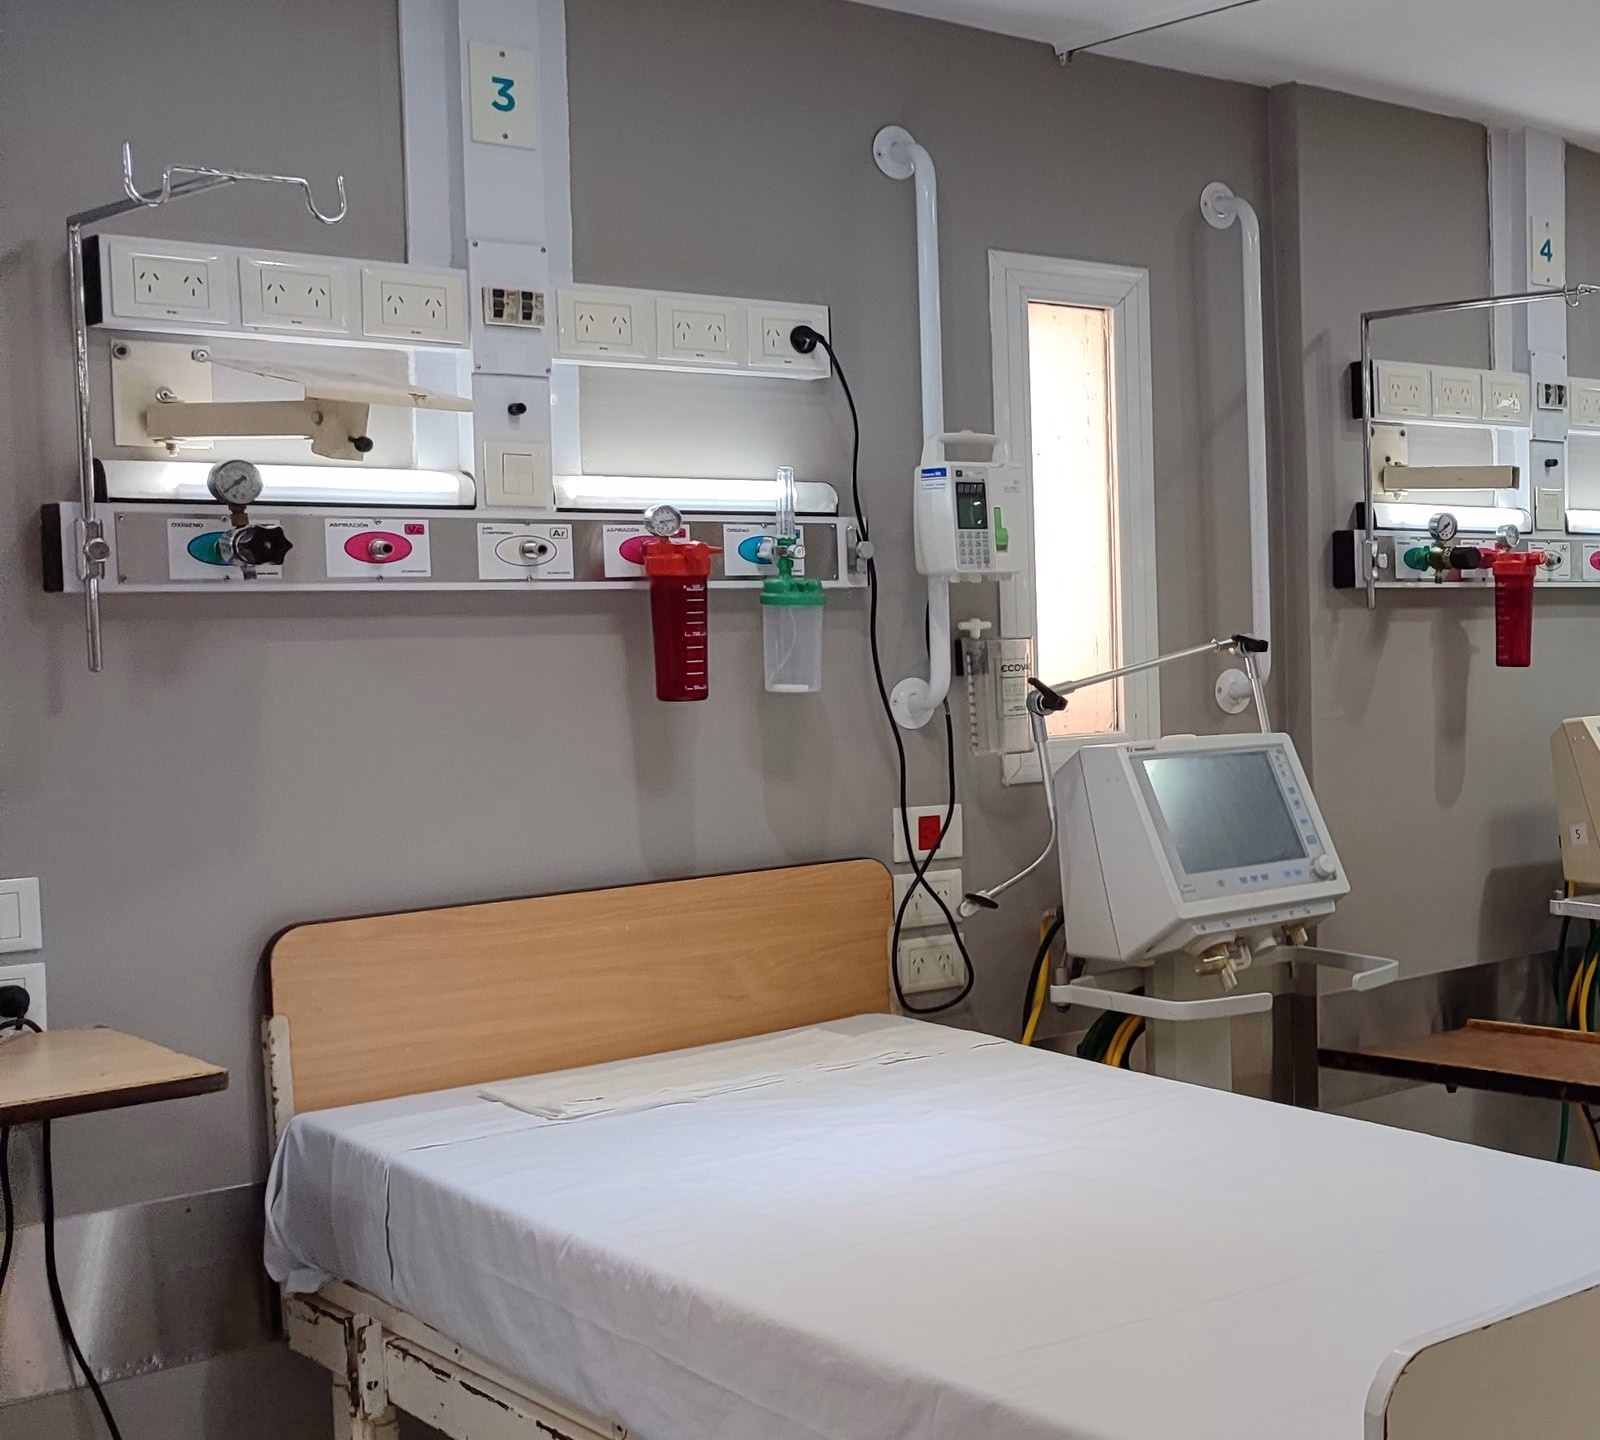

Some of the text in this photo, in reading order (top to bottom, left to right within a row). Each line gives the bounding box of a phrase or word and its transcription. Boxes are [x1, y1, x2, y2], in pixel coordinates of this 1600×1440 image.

[491, 75, 516, 112] 3
[1539, 238, 1553, 263] 4
[552, 529, 566, 537] Ar
